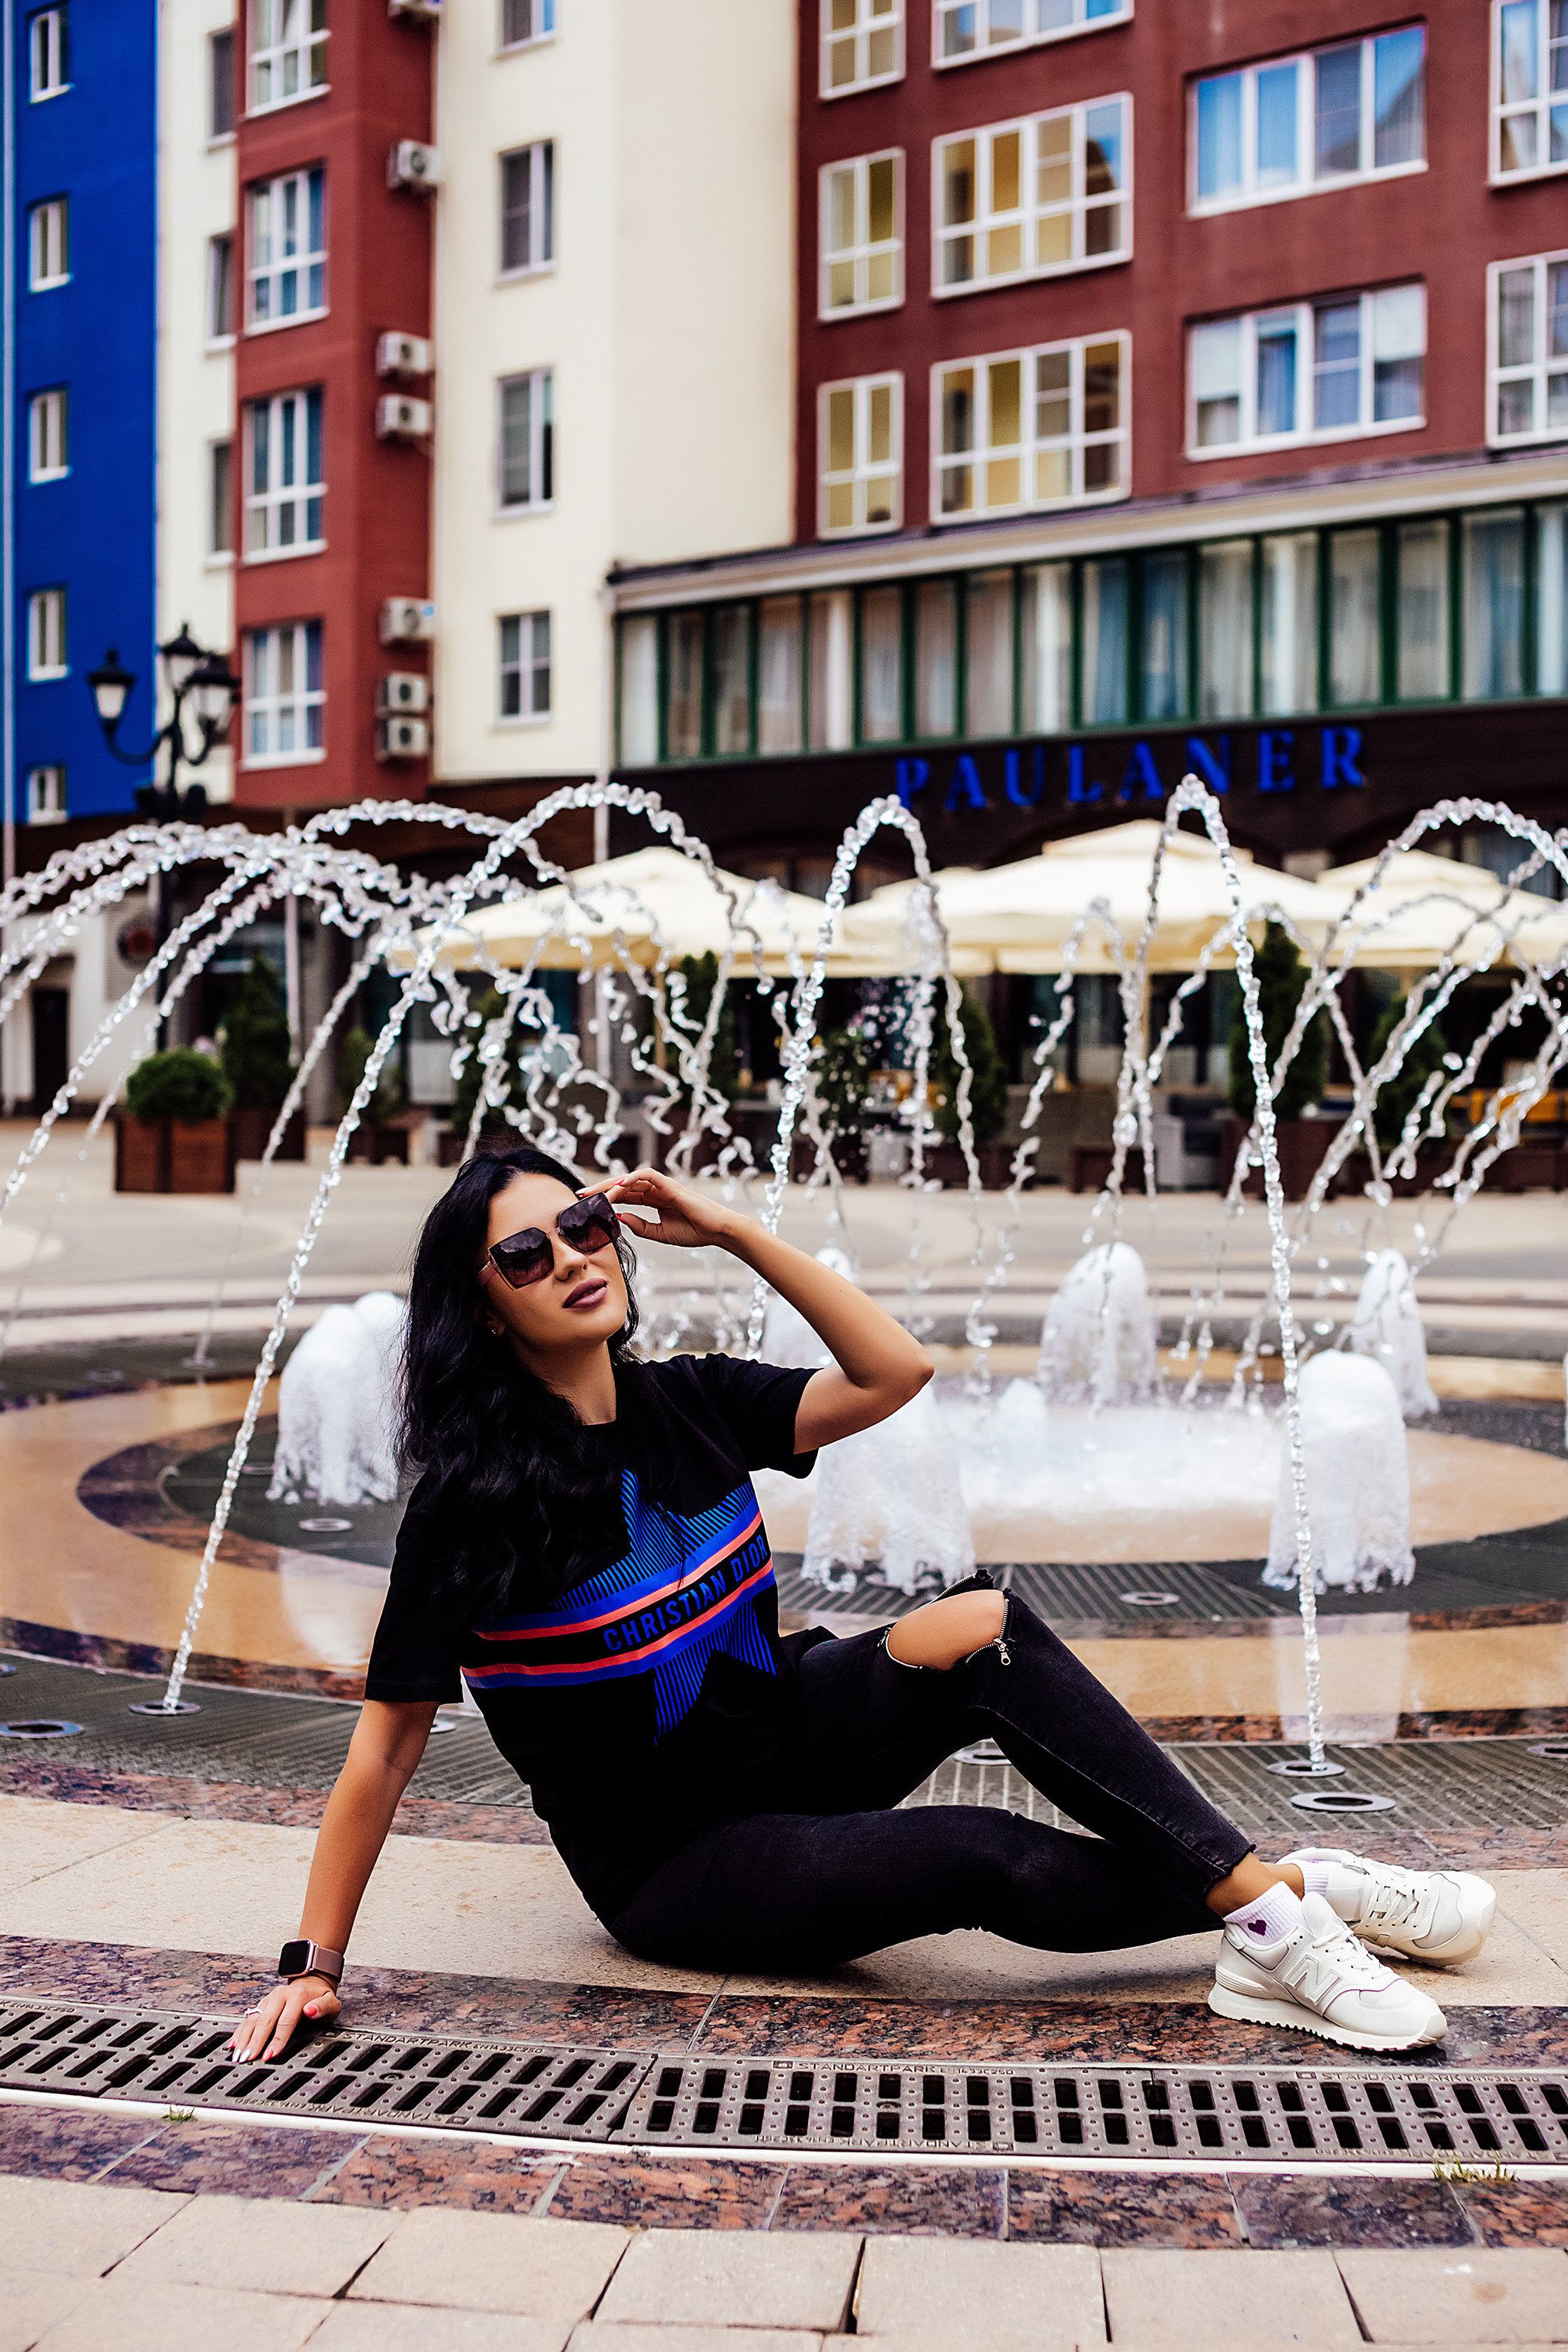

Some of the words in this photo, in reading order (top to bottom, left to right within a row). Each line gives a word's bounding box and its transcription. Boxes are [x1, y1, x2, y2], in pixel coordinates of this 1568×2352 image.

[895, 726, 1364, 812] PAULANER
[603, 1570, 726, 1652] CHRISTIAN
[731, 1534, 768, 1583] DIOR
[345, 2032, 472, 2049] STANDARTPARK
[798, 2061, 935, 2074] STANDARTPARK
